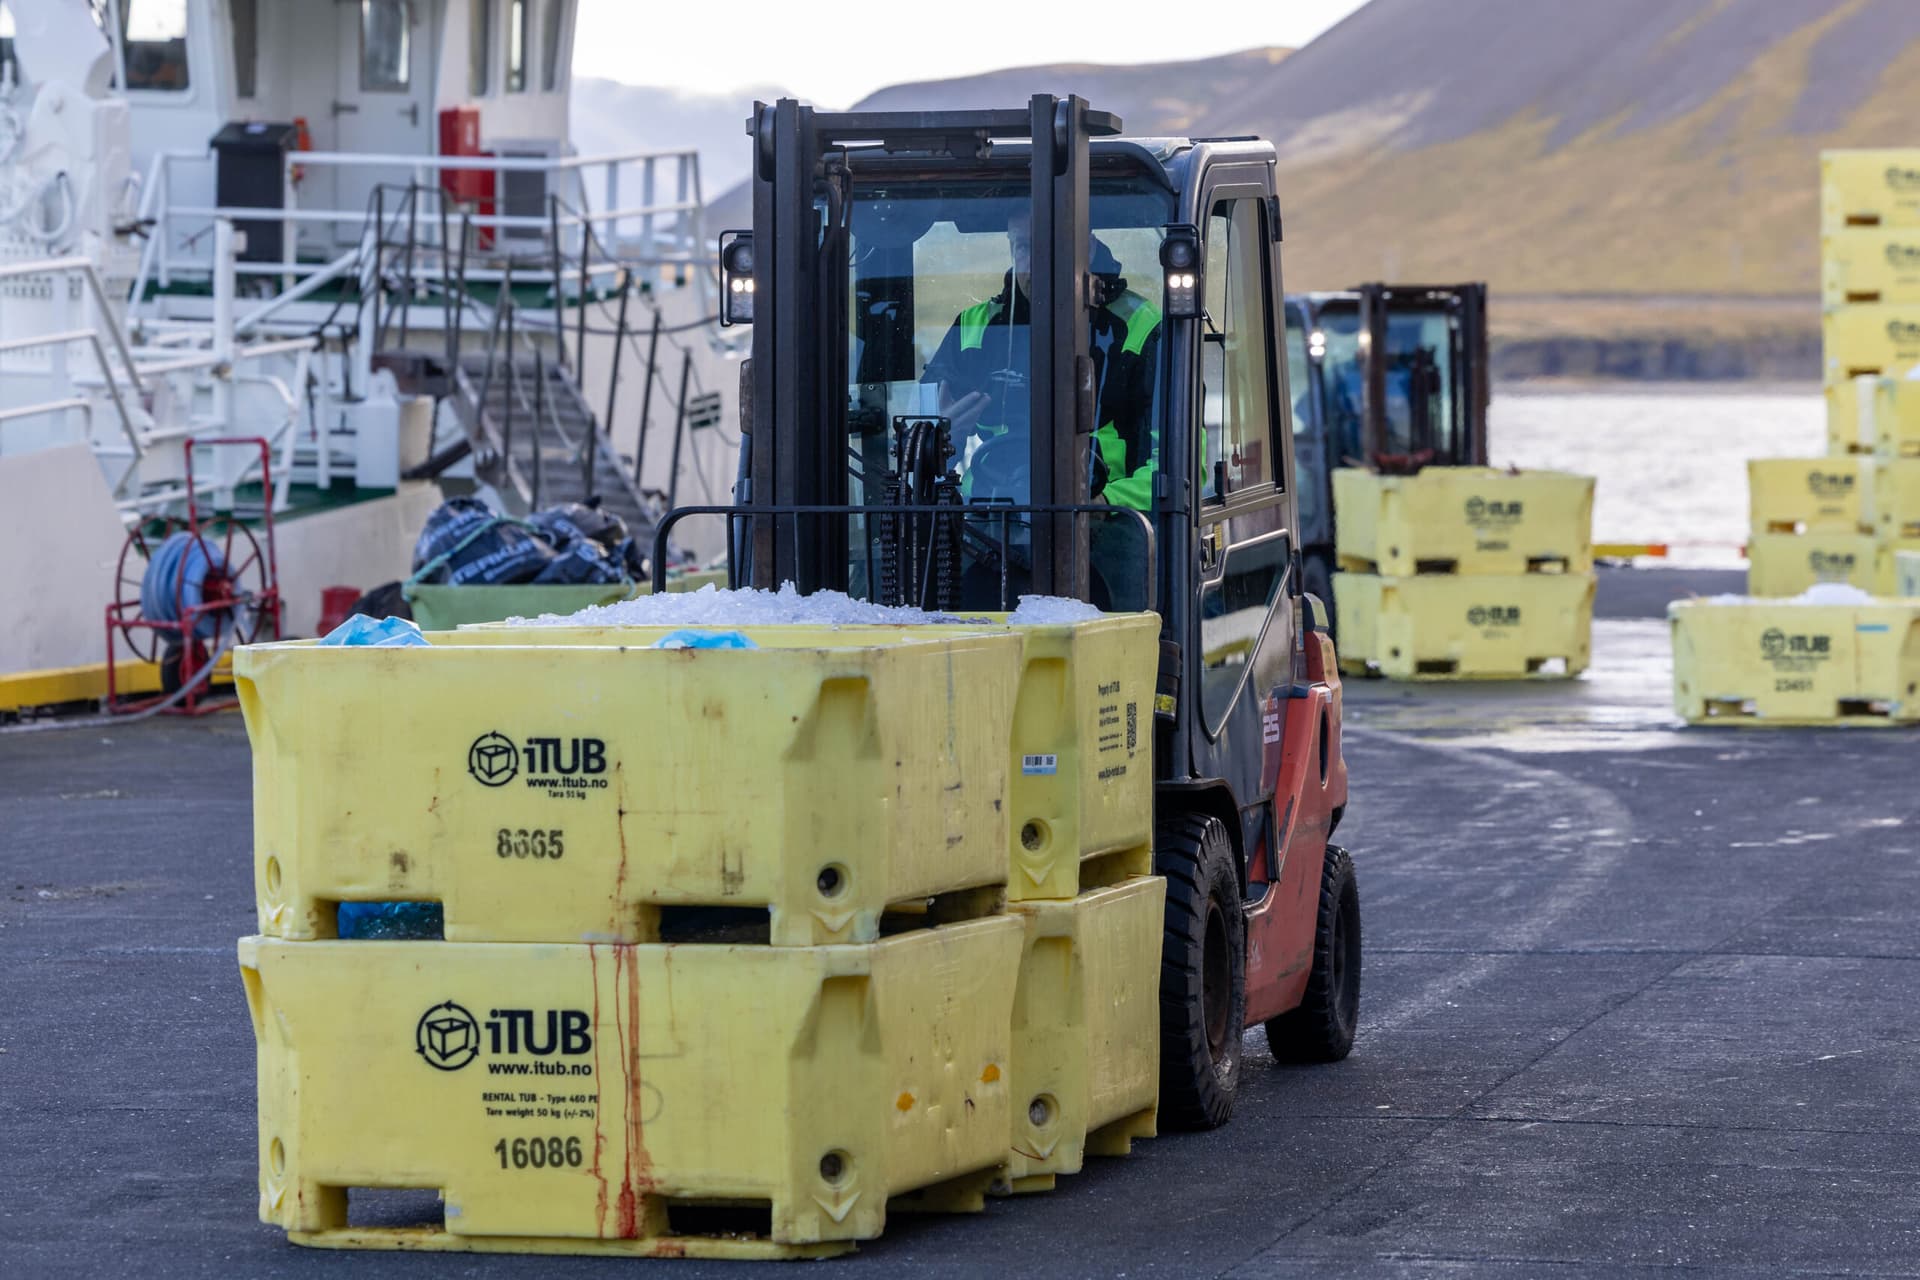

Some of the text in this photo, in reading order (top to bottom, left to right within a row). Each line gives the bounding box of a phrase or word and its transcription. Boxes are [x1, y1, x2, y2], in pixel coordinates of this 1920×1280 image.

[522, 737, 607, 775] iTUB
[526, 776, 608, 788] www.itub.no
[485, 1009, 592, 1055] iTUB
[488, 1061, 592, 1076] www.itub.no
[482, 1092, 516, 1102] RENTAL
[519, 1093, 537, 1102] TUB
[547, 1094, 567, 1104] Type
[570, 1095, 586, 1103] 460
[486, 1107, 503, 1116] Tare
[506, 1108, 534, 1118] weight
[537, 1108, 549, 1117] 50
[551, 1108, 561, 1119] kg
[494, 1136, 583, 1169] 16086
